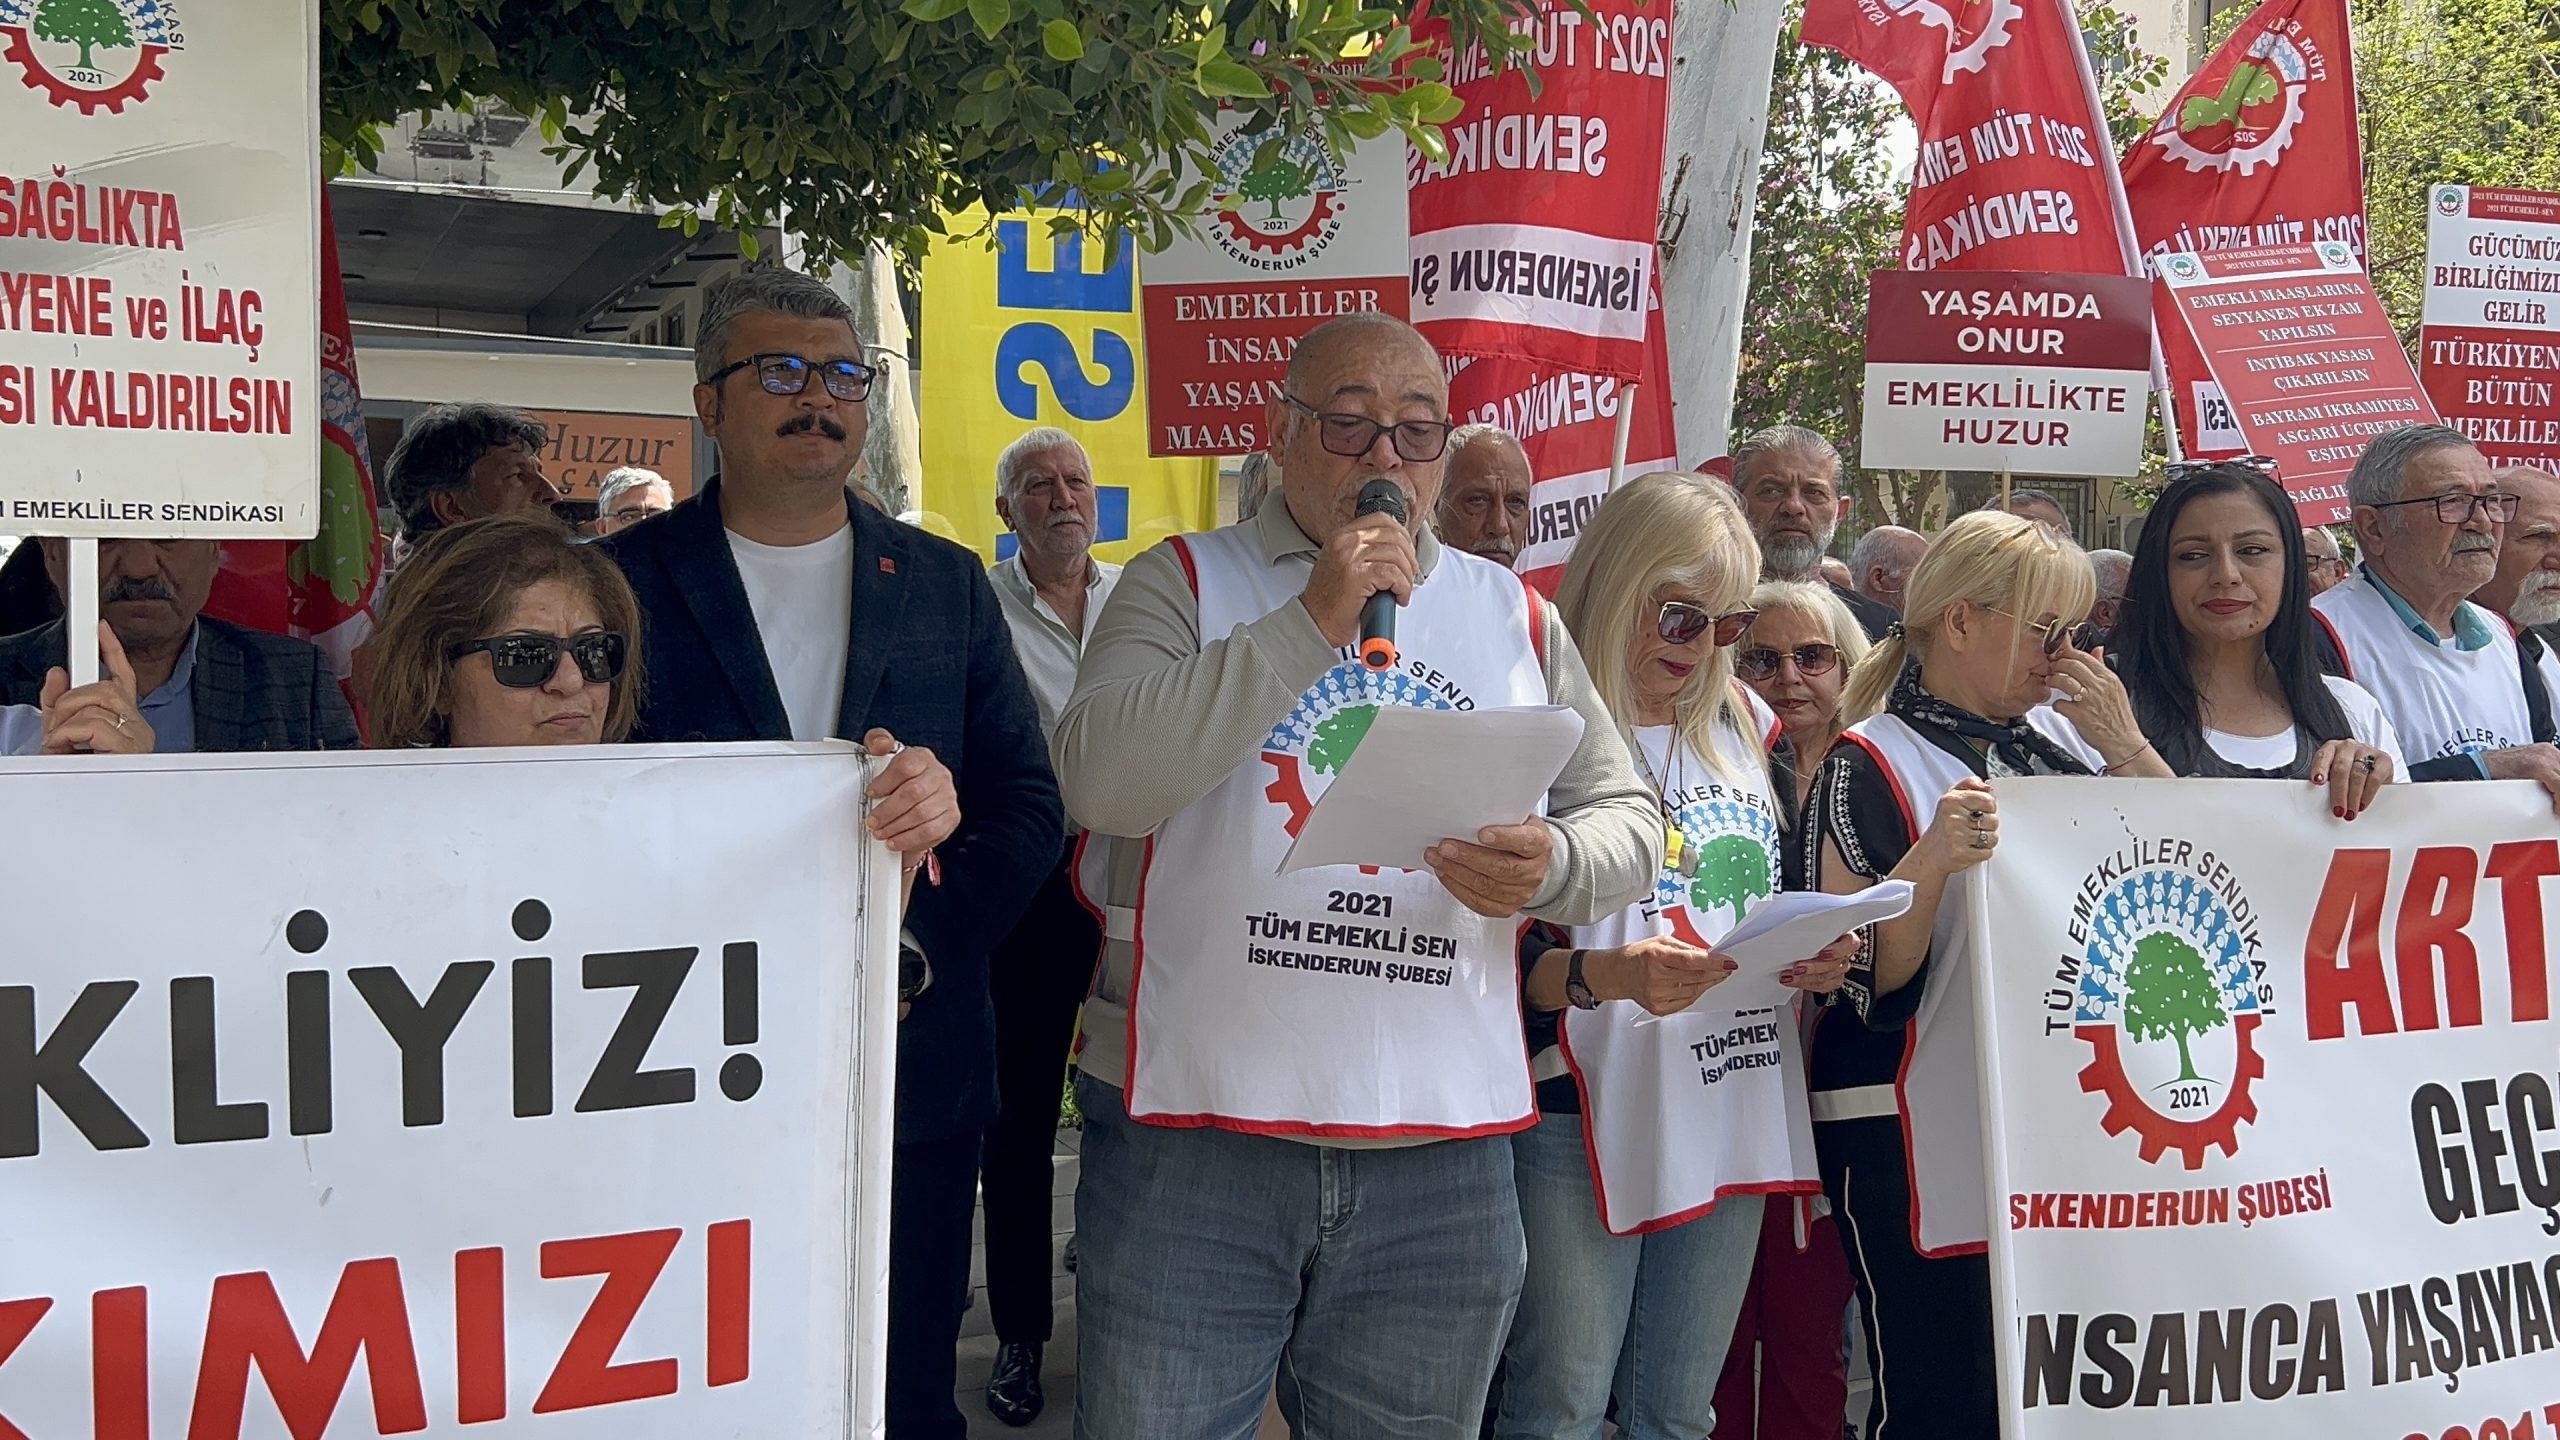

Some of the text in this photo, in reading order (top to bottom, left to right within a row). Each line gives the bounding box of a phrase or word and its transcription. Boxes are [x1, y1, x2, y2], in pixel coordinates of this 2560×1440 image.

[68, 70, 102, 84] 2021
[1263, 221, 1288, 230] 2021
[1208, 220, 1341, 271] İSKENDERUN ŞUBE
[1175, 286, 1380, 323] EMEKLİLER
[1922, 290, 2101, 321] YAŞAMDA
[2190, 282, 2365, 309] EMEKLİ MAAŞLARINA
[126, 295, 168, 341] ve
[182, 270, 263, 363] İLAÇ
[2212, 302, 2363, 327] SEYYANEN EK ZAM
[2484, 298, 2546, 324] GELİR
[1957, 327, 2064, 354] ONUR
[2258, 323, 2337, 342] YAPILSIN
[2247, 348, 2375, 373] İNTİBAK YASASI
[2274, 368, 2370, 391] ÇIKARILSIN
[2466, 376, 2553, 407] BÜTÜN
[51, 367, 291, 435] KALDIRILSIN
[1887, 377, 2126, 413] EMEKLİLİKTE
[2251, 396, 2419, 427] BAYRAM İKRAMİYESİ
[1166, 422, 1256, 453] MAAŞ
[1942, 419, 2070, 447] HUZUR
[2277, 422, 2339, 445] ASGARİ
[14, 499, 153, 520] EMEKLİLER
[161, 501, 284, 522] SENDİKASI
[1327, 889, 1393, 918] 2021
[1246, 911, 1458, 960] TÜM EMEKLİ SEN
[2043, 838, 2276, 1037] TÜM EMEKLİLER SENDİKASI
[2304, 840, 2560, 1041] ART
[1247, 943, 1453, 988] İSKENDERUN ŞUBESİ
[2169, 1086, 2210, 1110] 2021
[2237, 1167, 2333, 1228] ŞUBESİ
